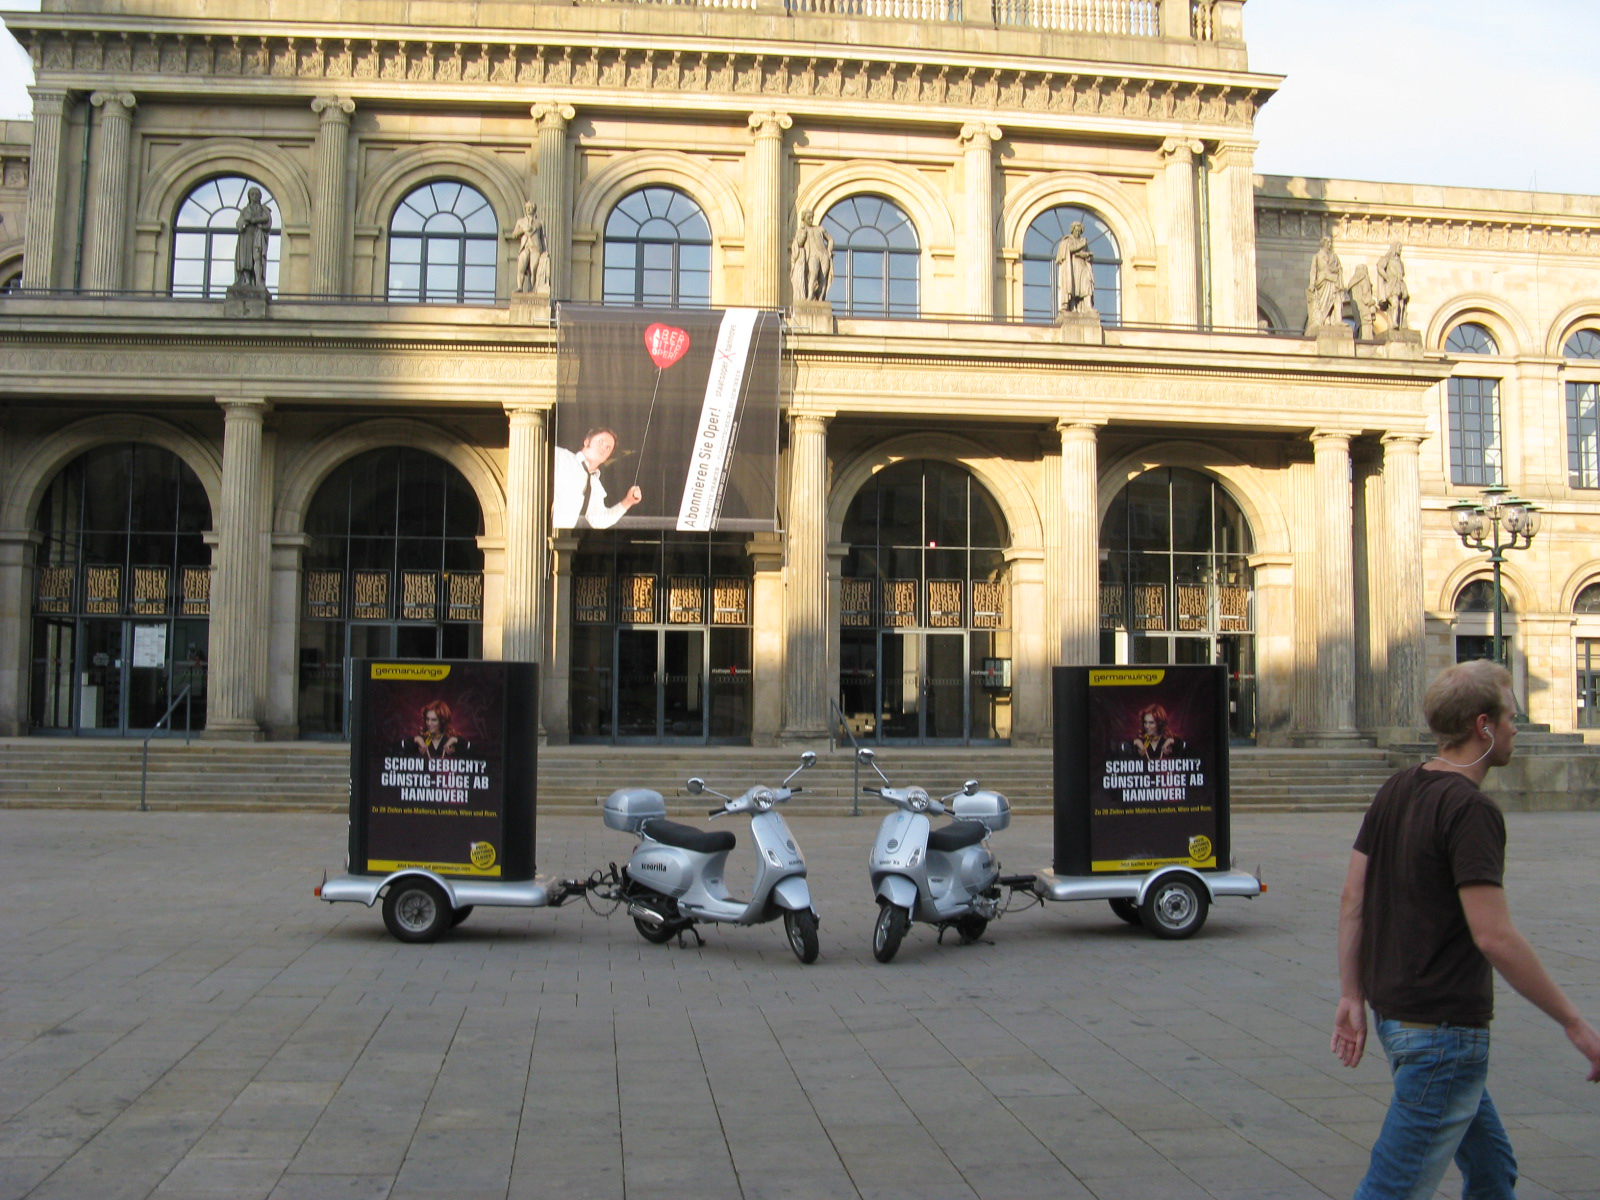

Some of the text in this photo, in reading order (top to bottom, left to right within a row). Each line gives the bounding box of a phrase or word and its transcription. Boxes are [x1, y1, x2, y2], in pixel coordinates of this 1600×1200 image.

[652, 328, 684, 346] ABER
[652, 339, 681, 354] BITTE
[652, 348, 678, 360] OPER!
[684, 408, 720, 528] Abonnieren Sie Oper!
[376, 668, 442, 677] germanwings
[1094, 673, 1158, 682] germanwings
[384, 758, 486, 774] SCHON GEBUCHT?
[1106, 758, 1200, 774] SCHON GEBUCHT?
[382, 770, 489, 790] GÜNSTIG-FLÜGE AB
[1103, 774, 1204, 788] GÜNSTIG-FLÜGE AB
[401, 788, 468, 802] HANNOVER!
[1122, 788, 1186, 802] HANNOVER!
